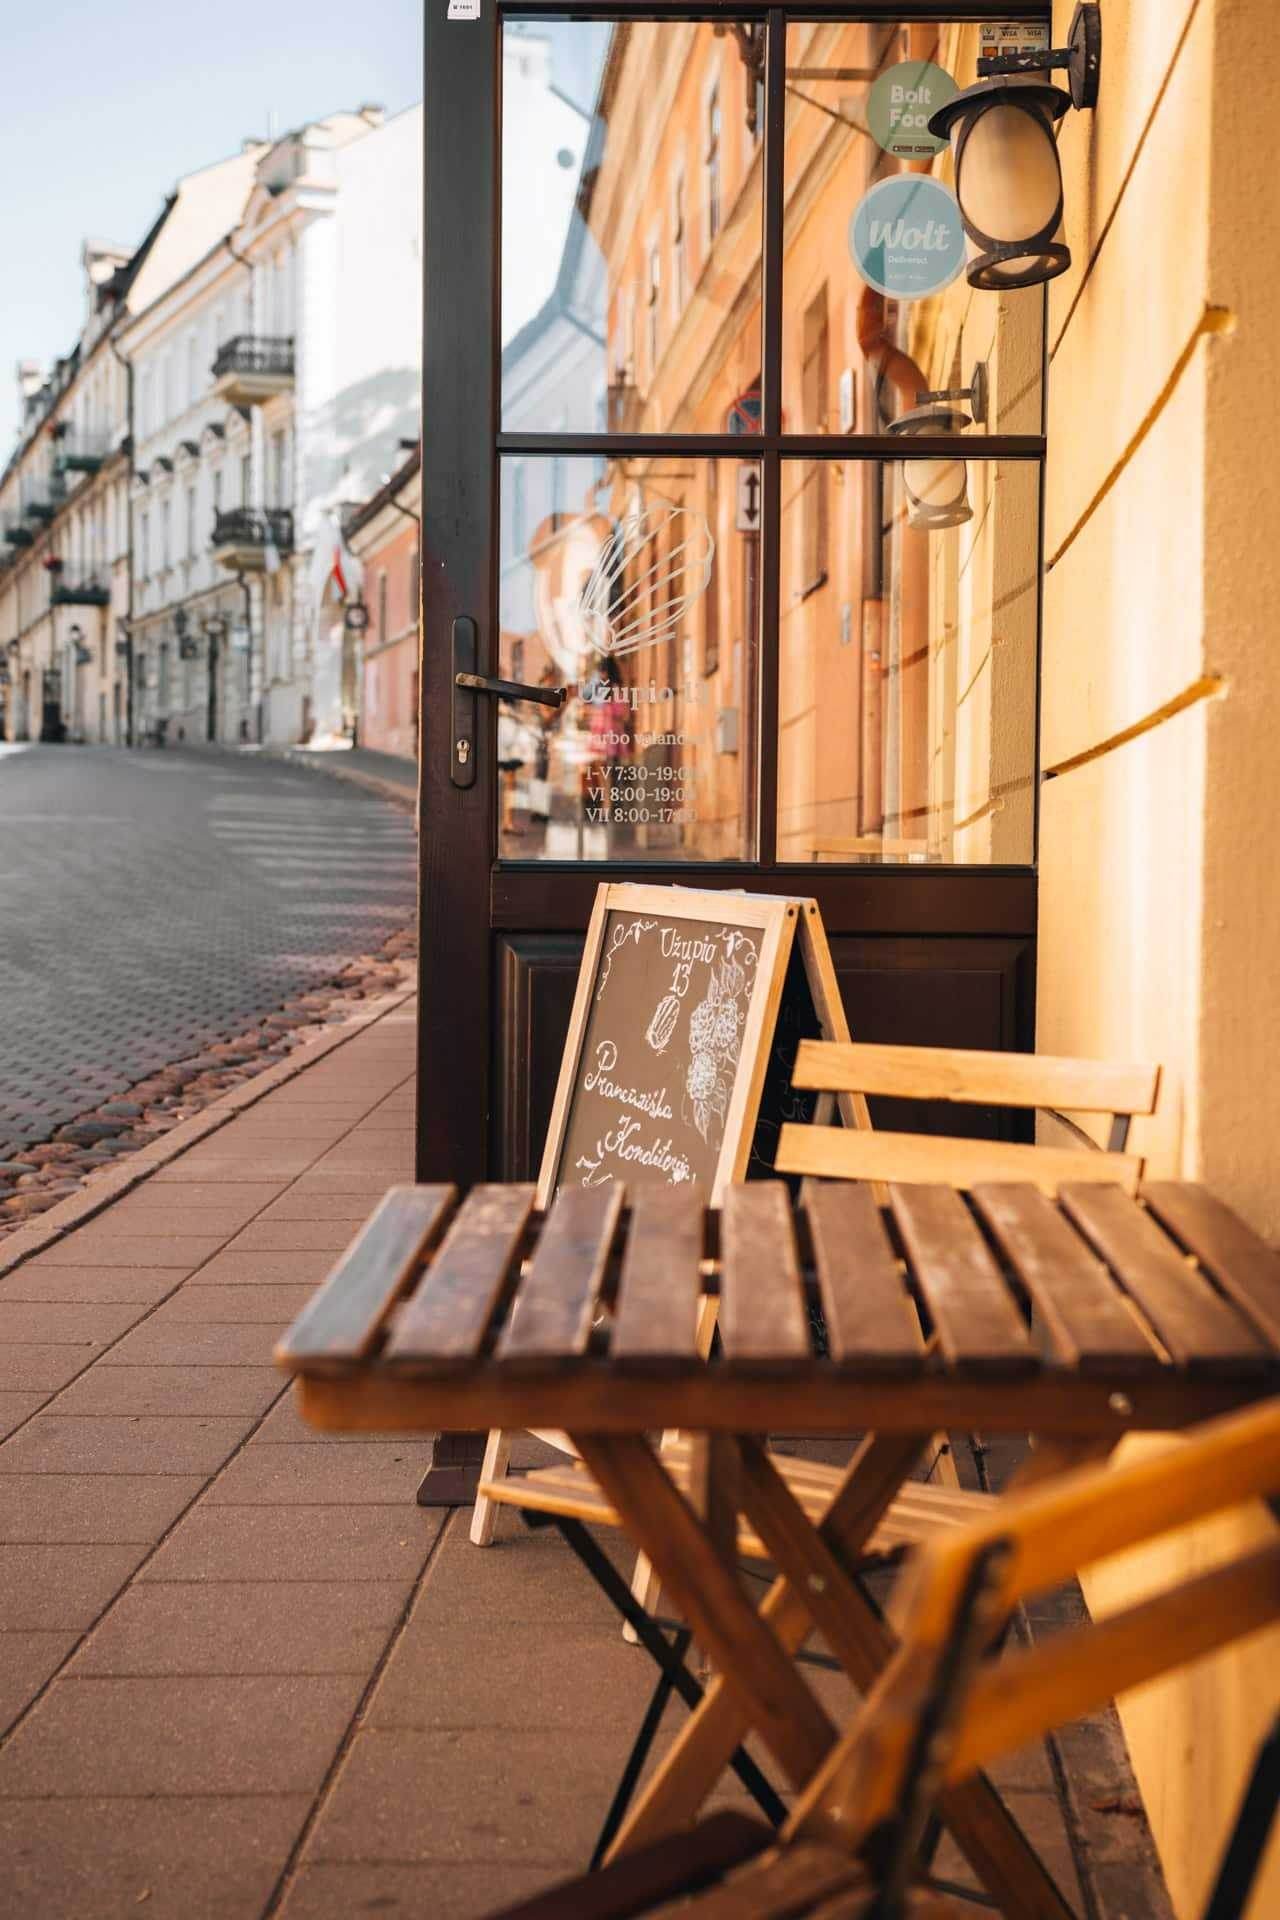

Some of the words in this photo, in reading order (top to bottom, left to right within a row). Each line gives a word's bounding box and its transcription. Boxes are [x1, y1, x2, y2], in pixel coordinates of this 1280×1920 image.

[890, 85, 931, 104] Bolt
[889, 108, 929, 128] Foo
[869, 219, 950, 250] Wolt
[577, 679, 674, 711] Užupio
[588, 787, 606, 802] VI
[586, 808, 610, 822] VII
[660, 928, 717, 975] Užupio
[670, 963, 690, 997] 13
